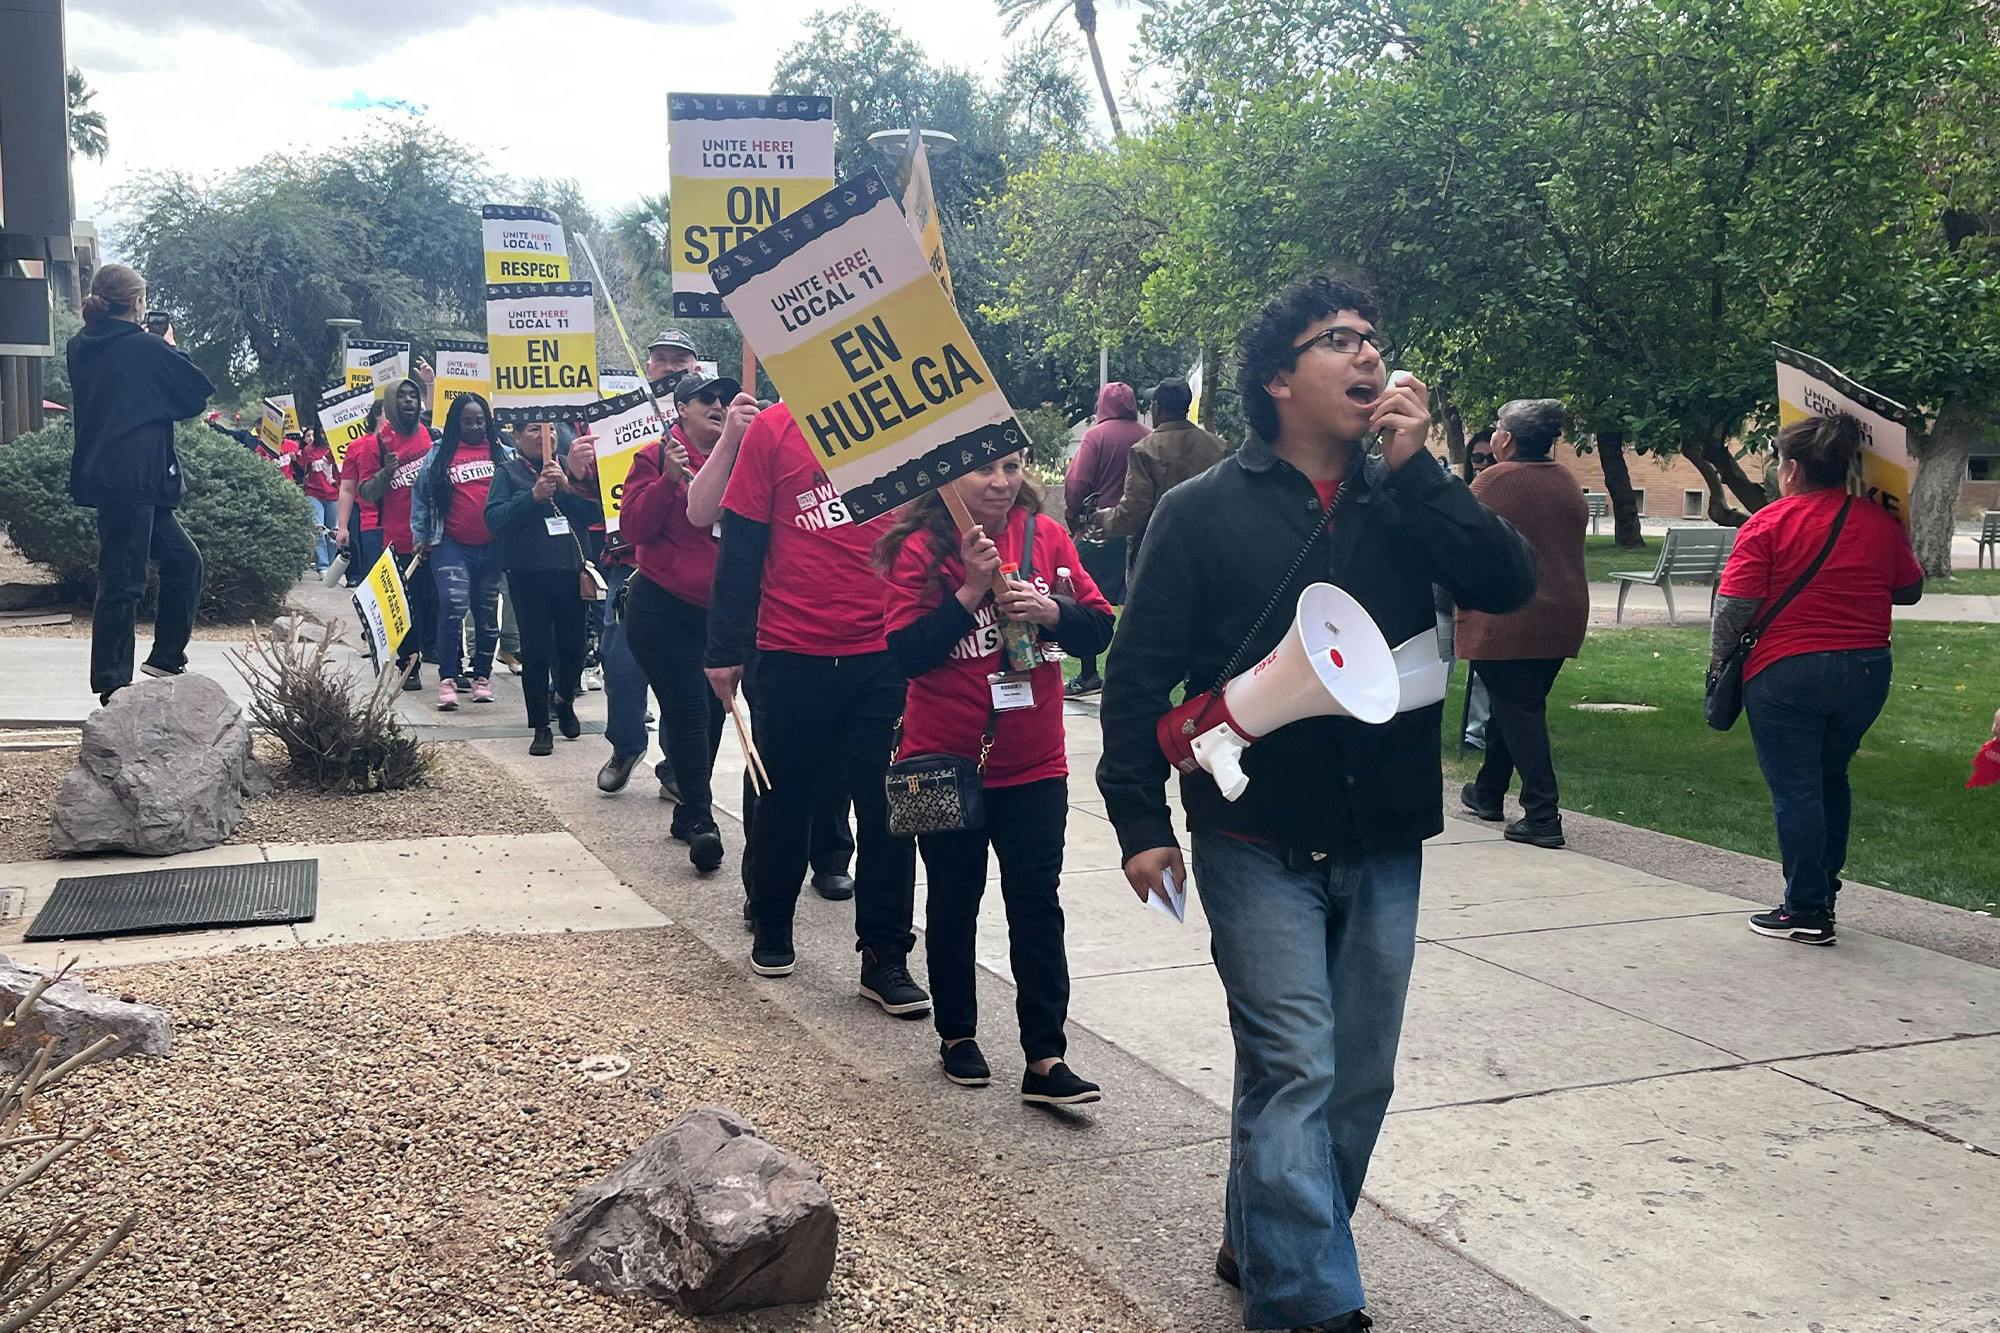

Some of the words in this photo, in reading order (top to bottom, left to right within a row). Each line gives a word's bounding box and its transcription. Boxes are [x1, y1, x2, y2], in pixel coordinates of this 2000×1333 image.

[702, 139, 747, 152] UNITE
[752, 140, 793, 153] HERE!
[703, 153, 767, 169] LOCAL
[777, 154, 795, 169] 11
[726, 186, 781, 226] ON
[502, 231, 529, 240] UNITE
[531, 232, 551, 241] HERE!
[503, 239, 540, 250] LOCAL
[543, 242, 552, 252] 11
[500, 260, 560, 279] RESPECT
[770, 275, 824, 312] UNITE
[822, 248, 872, 285] HERE!
[780, 282, 855, 332] LOCAL
[858, 265, 884, 289] 11
[508, 310, 538, 319] UNITE
[539, 309, 568, 318] HERE!
[508, 318, 552, 329] LOCAL
[557, 318, 570, 329] 11
[527, 339, 560, 363] EN
[830, 315, 903, 383] EN
[446, 367, 470, 377] LOCAL
[471, 369, 478, 377] 11
[496, 364, 594, 390] HUELGA
[806, 342, 984, 458] HUELGA
[1803, 386, 1837, 411] UNITE
[1804, 396, 1835, 418] LOC
[332, 409, 349, 418] UNITE
[334, 412, 358, 424] LOCAL
[614, 420, 644, 436] UNITE
[646, 408, 675, 424] HERE!
[615, 423, 660, 445] LOCAL
[390, 475, 405, 490] ON
[461, 464, 495, 480] STRIK
[795, 508, 825, 531] ON
[1254, 649, 1278, 675] PYLE
